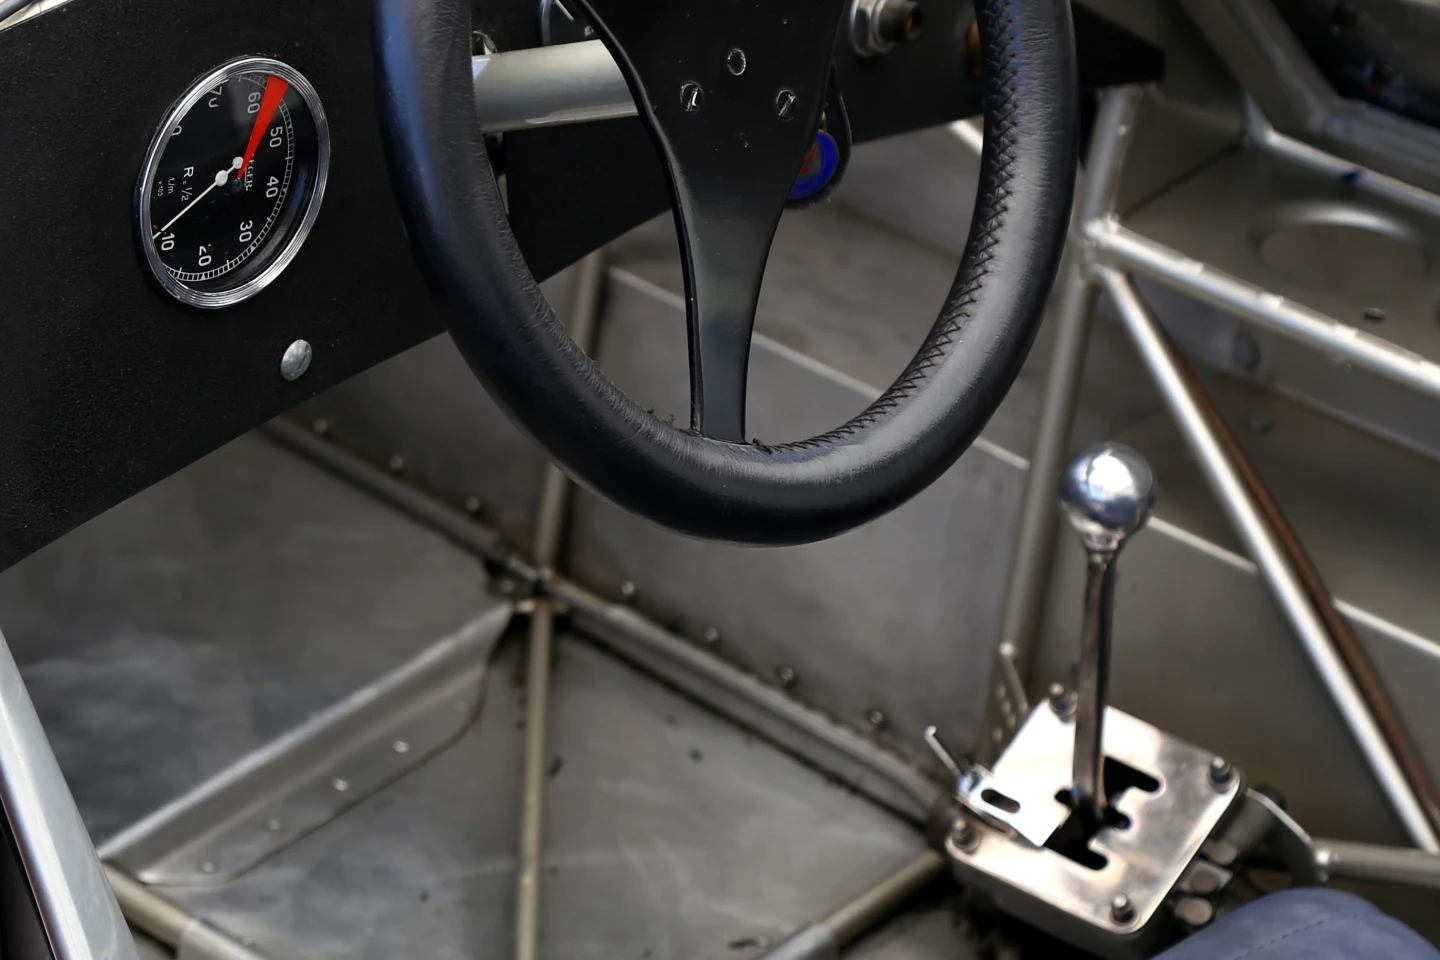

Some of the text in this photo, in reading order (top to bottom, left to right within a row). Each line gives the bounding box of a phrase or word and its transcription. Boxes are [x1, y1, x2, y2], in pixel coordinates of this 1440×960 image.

[247, 91, 261, 114] 60
[269, 126, 283, 148] 50
[183, 166, 194, 178] R
[265, 176, 279, 198] 40
[161, 232, 175, 252] 10
[239, 219, 253, 243] 30
[198, 245, 212, 267] 20
